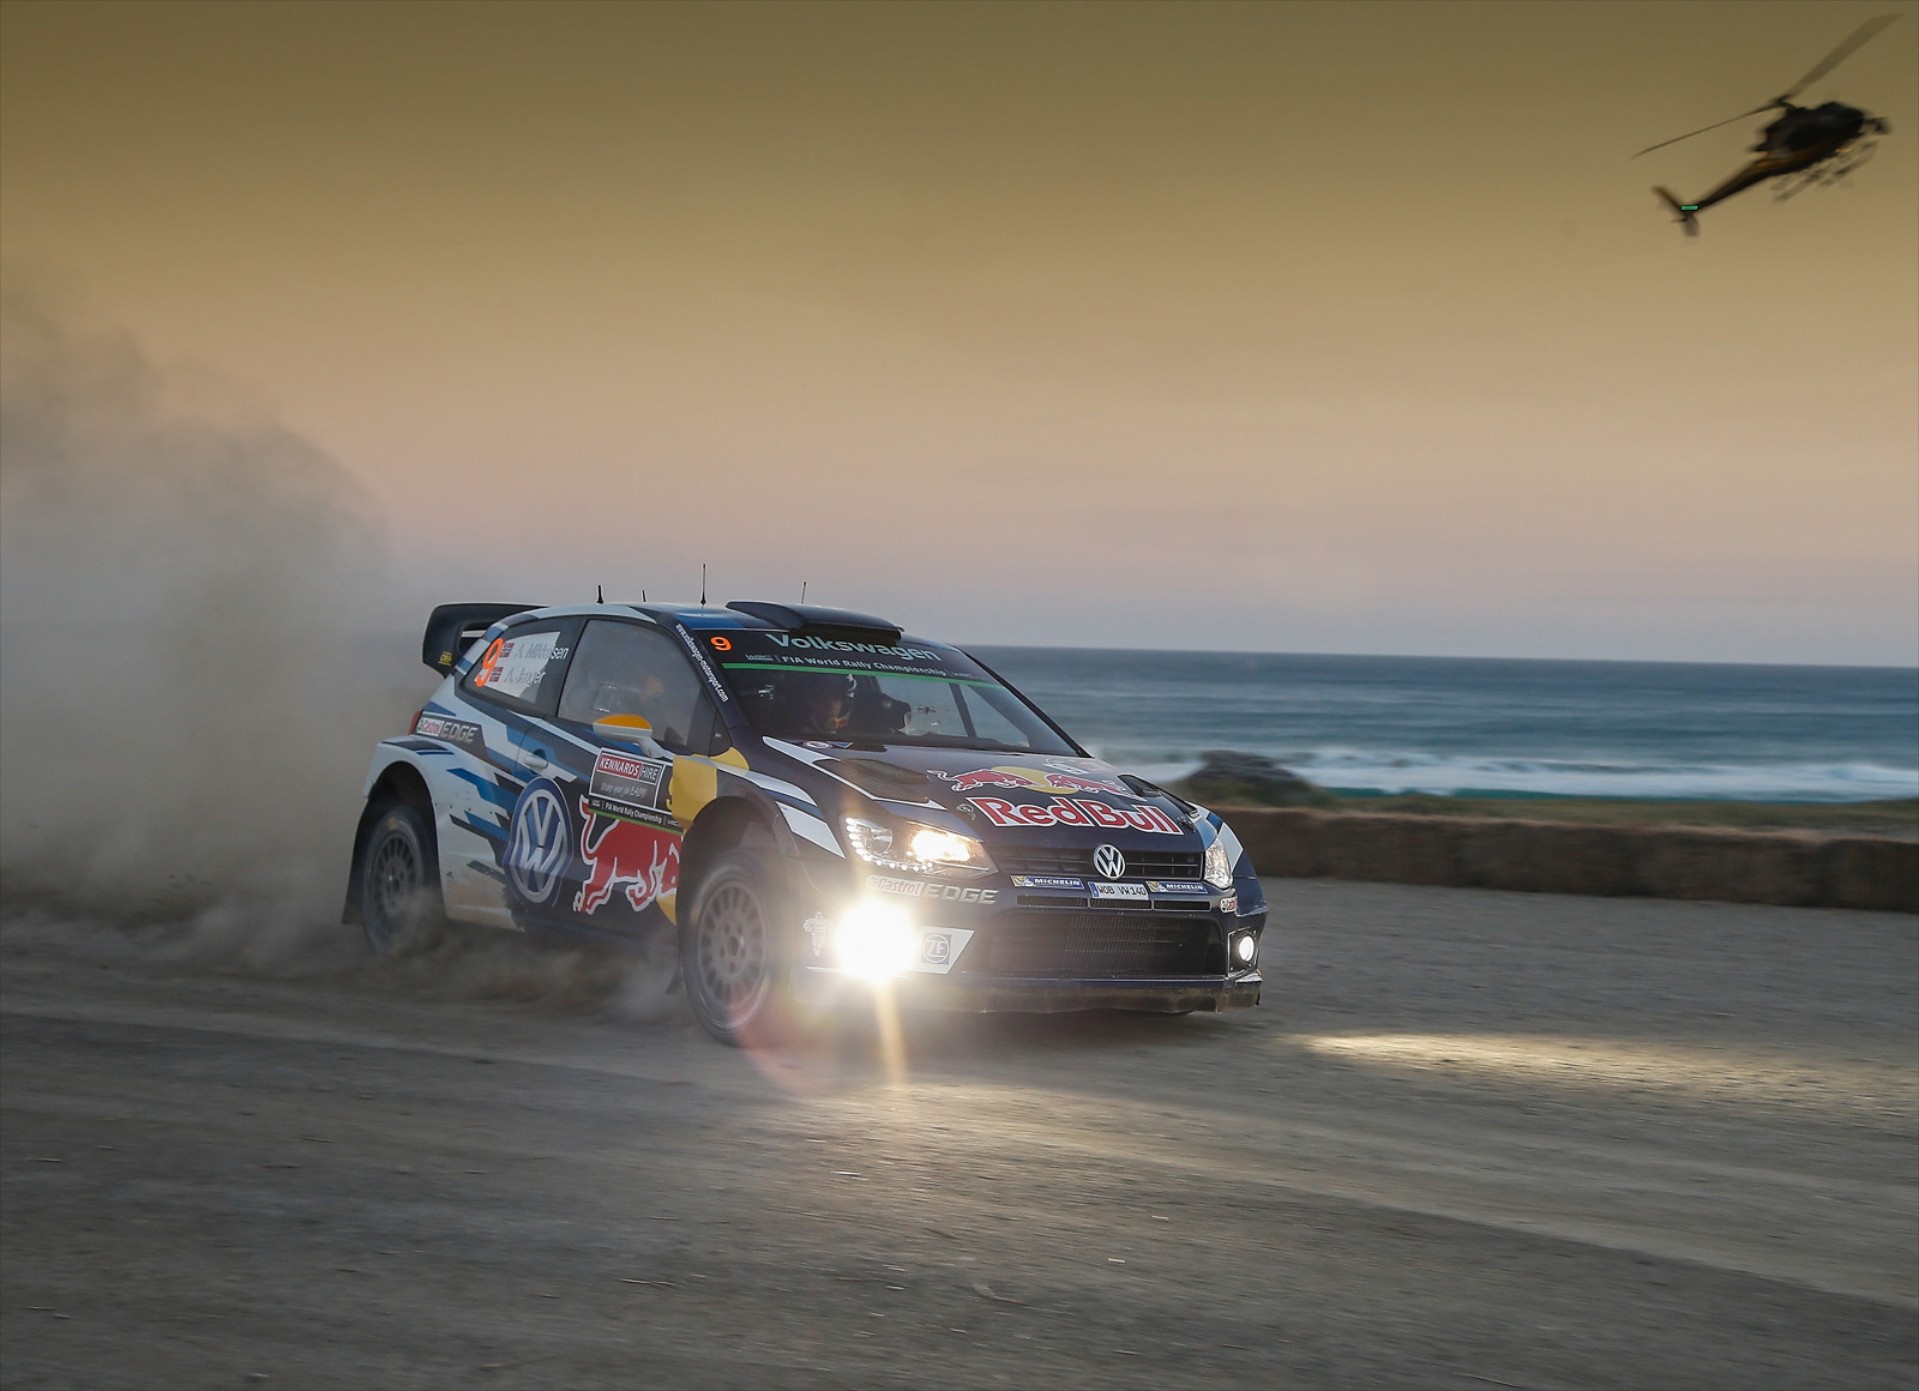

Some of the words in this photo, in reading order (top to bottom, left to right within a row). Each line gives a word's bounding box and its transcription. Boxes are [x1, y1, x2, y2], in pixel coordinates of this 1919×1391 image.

[711, 637, 731, 651] 9
[765, 633, 942, 661] Volkswagen
[474, 638, 505, 687] 9
[781, 656, 803, 664] FIA
[805, 657, 841, 666] World
[842, 660, 872, 670] Rally
[872, 662, 947, 677] Championship
[441, 722, 479, 744] EDGE
[599, 757, 640, 777] KENNARDS
[641, 766, 659, 780] HIRE
[605, 802, 613, 811] FIA
[612, 804, 624, 814] World
[624, 807, 634, 817] Rally
[634, 809, 662, 824] Championship
[966, 797, 1094, 827] Red
[1072, 799, 1185, 835] Bull
[876, 877, 922, 897] Castrol
[924, 883, 1000, 905] EDGE
[1034, 877, 1082, 887] MICHELIN
[1097, 885, 1115, 894] WOB
[1165, 882, 1205, 890] MICHELIN
